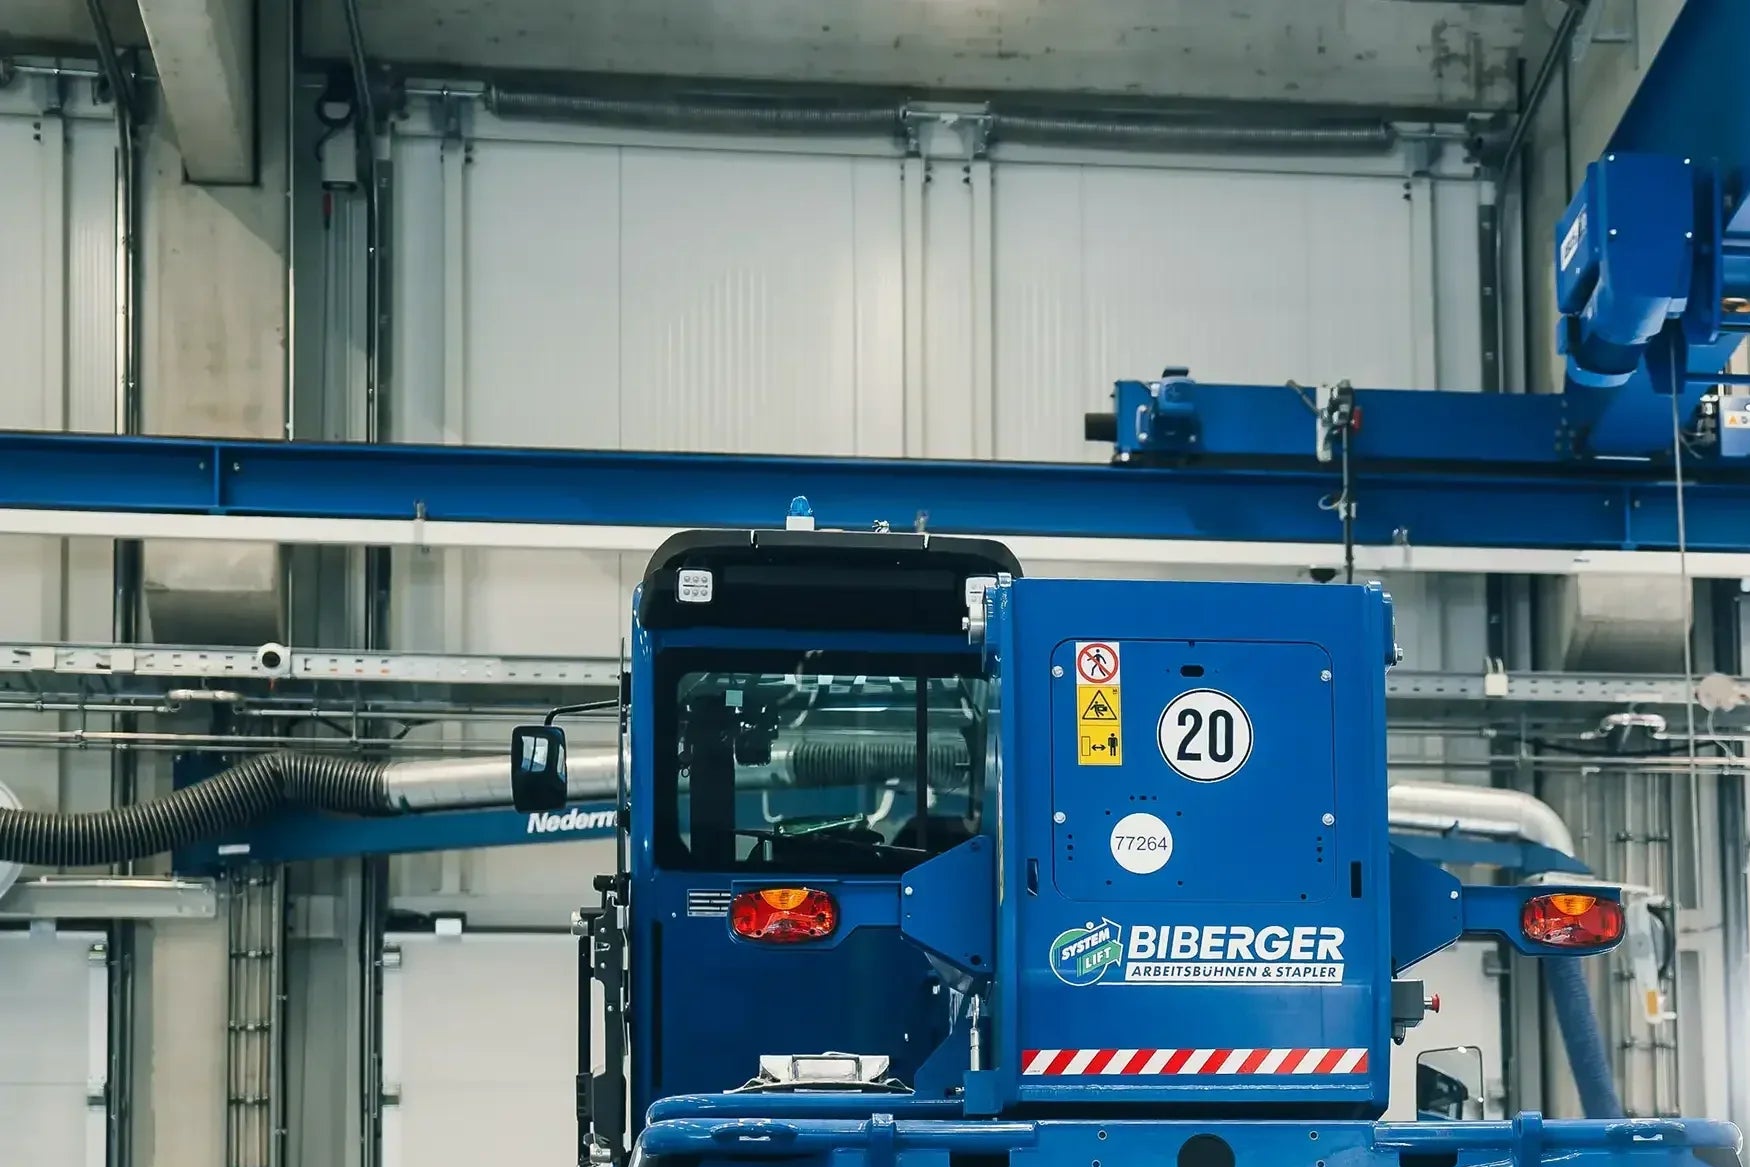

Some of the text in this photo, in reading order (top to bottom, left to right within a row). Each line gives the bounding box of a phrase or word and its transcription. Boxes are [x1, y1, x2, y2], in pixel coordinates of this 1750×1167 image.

[1177, 708, 1234, 763] 20
[527, 808, 618, 834] Nederm
[1115, 836, 1168, 851] 77264
[1061, 927, 1111, 961] SYSTEM
[1127, 925, 1345, 961] BIBERGER
[1085, 946, 1112, 970] LIFT
[1131, 965, 1337, 978] ARBEITSBÜHNEN & STAPLER
